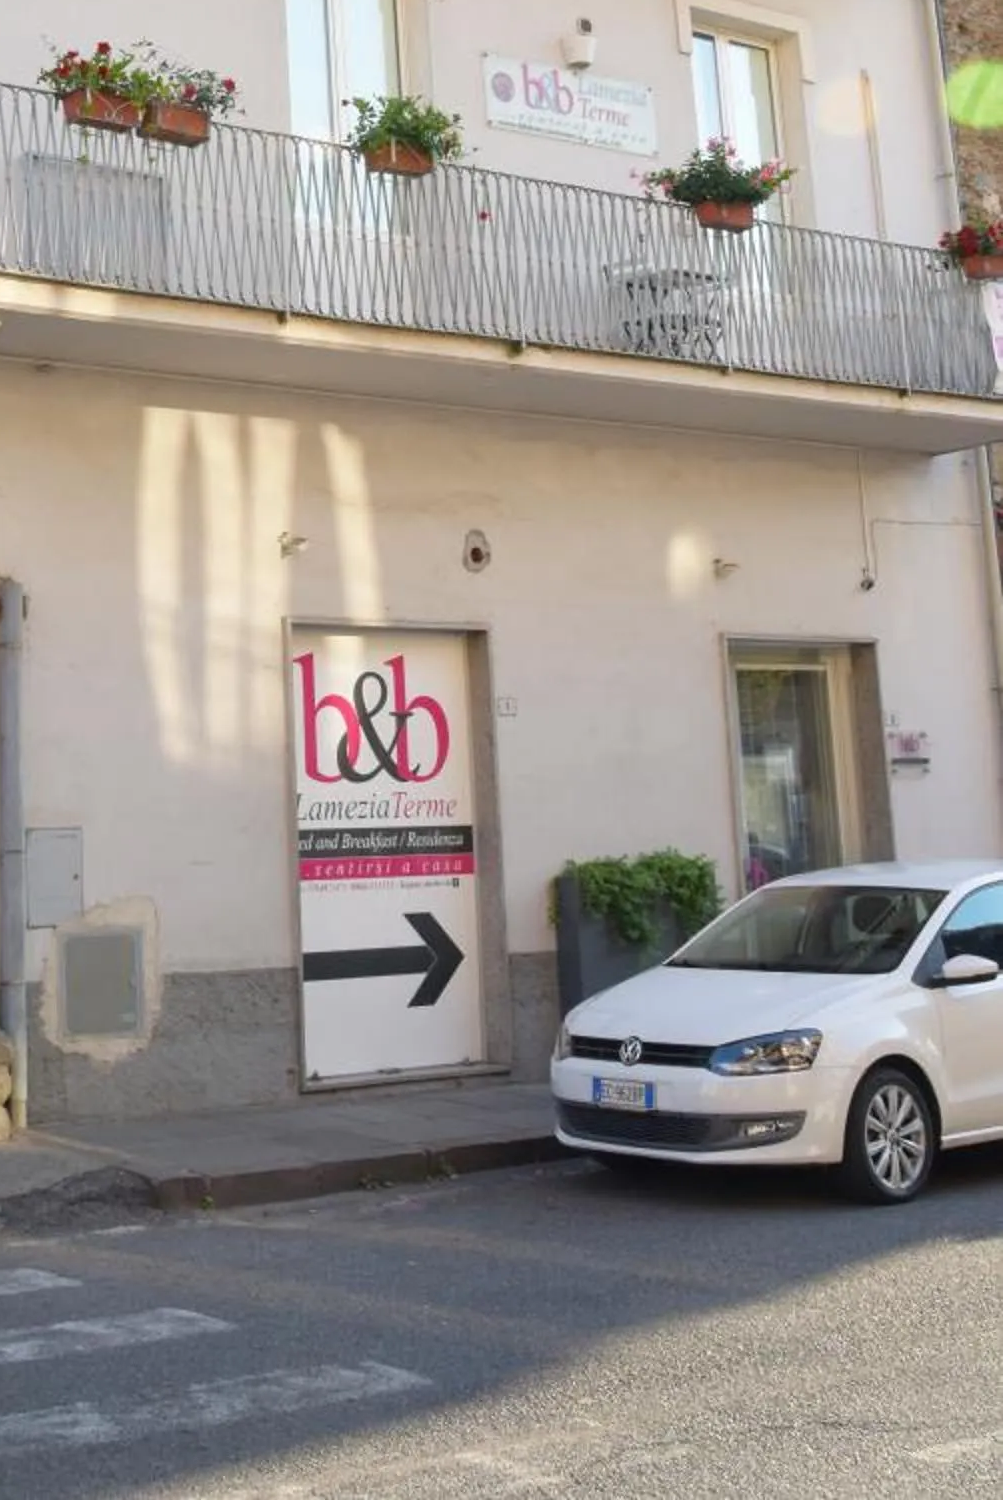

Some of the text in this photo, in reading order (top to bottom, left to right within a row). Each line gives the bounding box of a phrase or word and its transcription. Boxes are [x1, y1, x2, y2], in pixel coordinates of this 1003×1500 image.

[522, 62, 575, 115] b&b
[578, 97, 631, 128] Terme
[293, 651, 450, 784] b&b
[298, 833, 314, 851] ed
[315, 832, 340, 850] and
[341, 831, 397, 853] Breakfast
[406, 829, 464, 849] Residenza
[402, 861, 410, 874] a
[422, 859, 462, 873] casa
